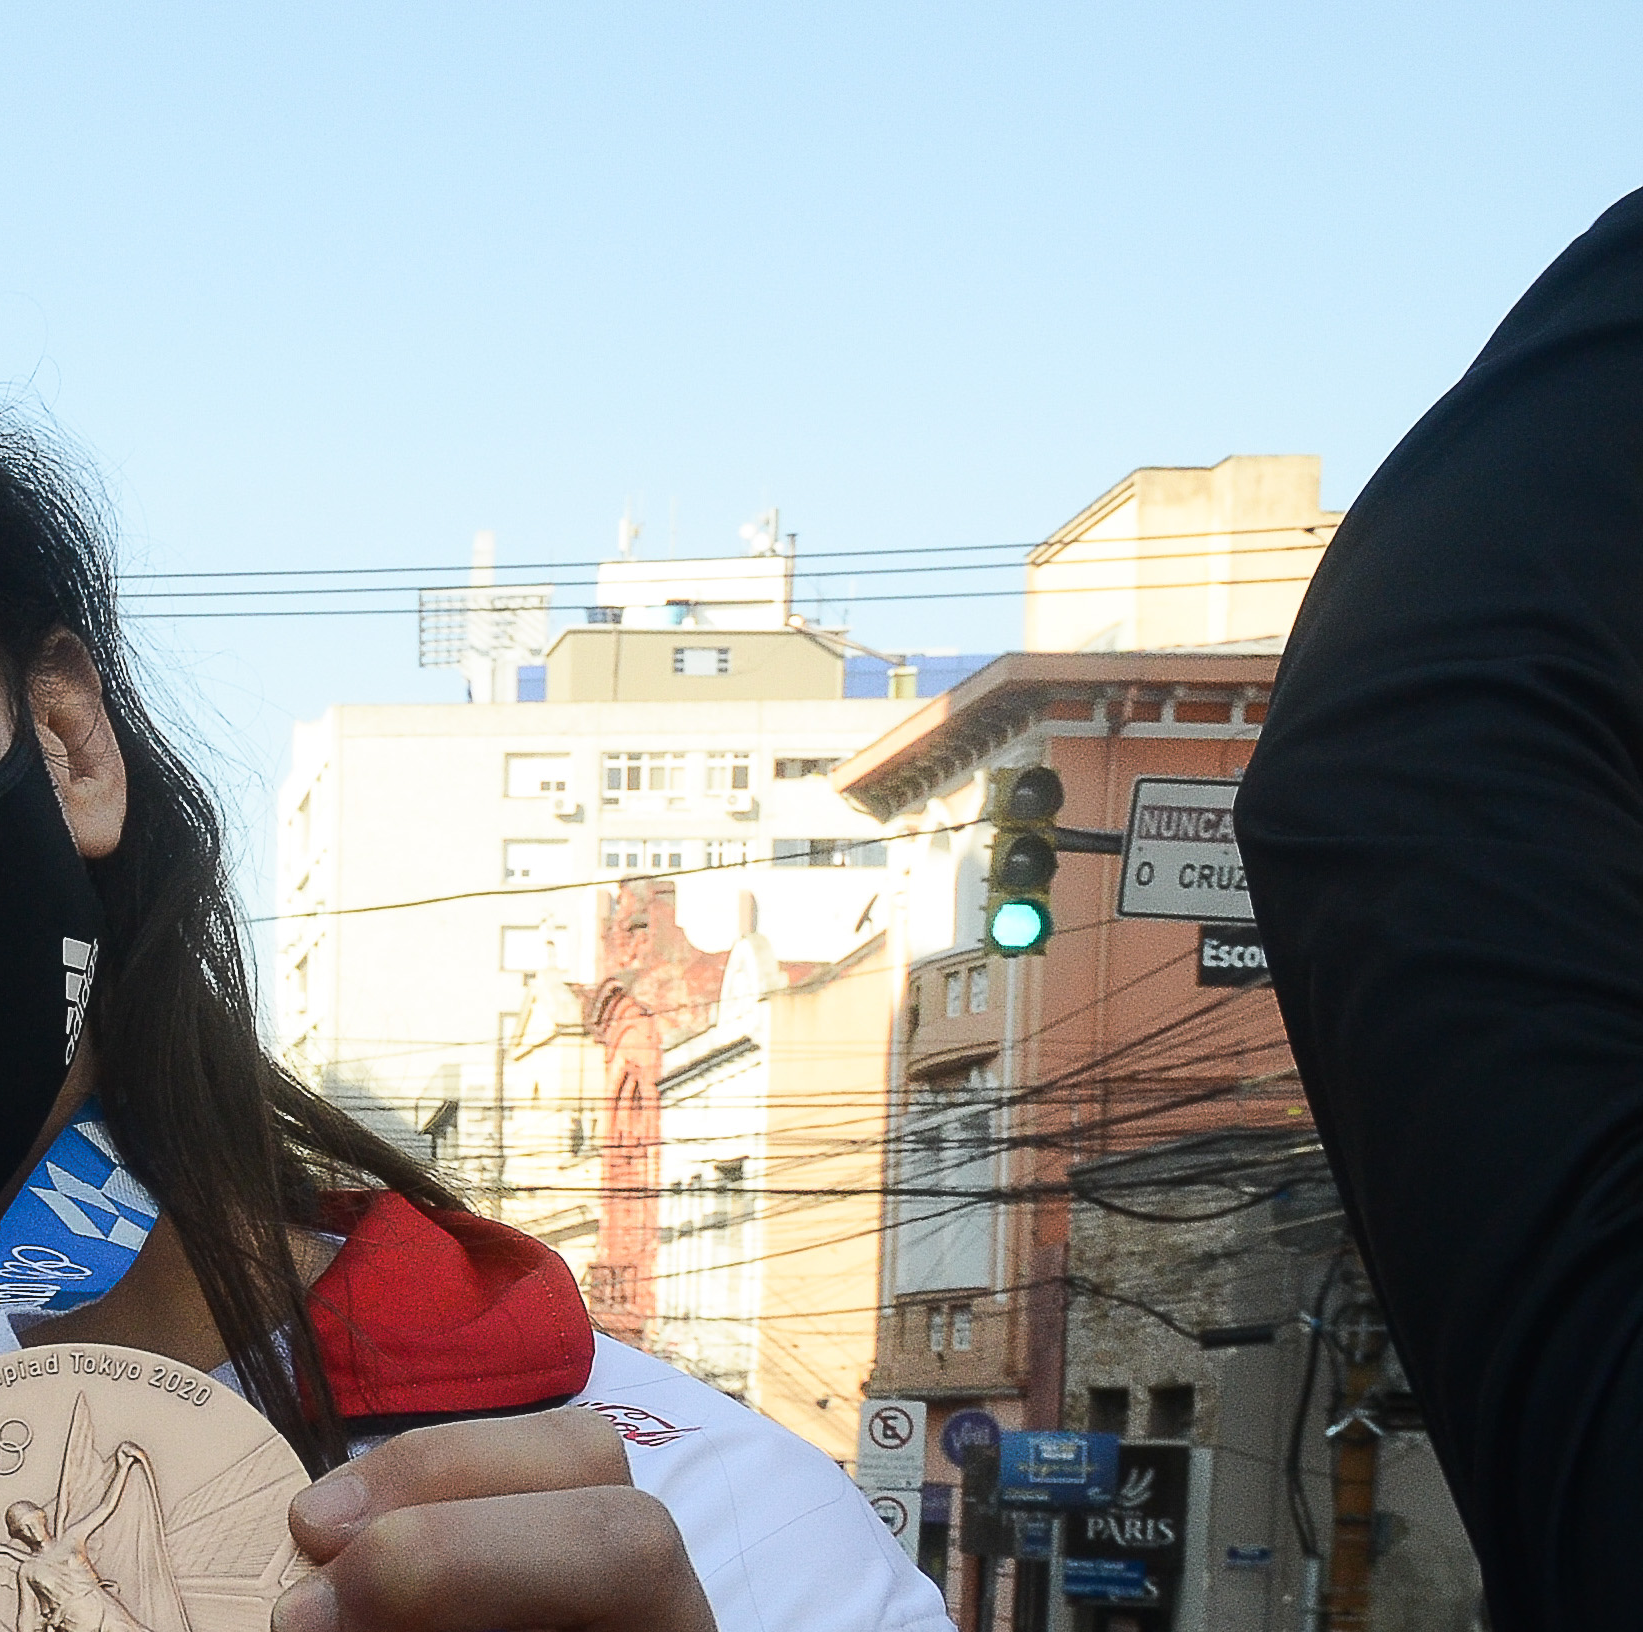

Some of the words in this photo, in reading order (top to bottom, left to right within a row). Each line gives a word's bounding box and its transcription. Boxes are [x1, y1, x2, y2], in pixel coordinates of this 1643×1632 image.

[1139, 808, 1234, 839] NUNCA
[1135, 861, 1155, 886] O
[69, 1351, 143, 1380] Tokyo
[148, 1365, 213, 1407] 2020
[1086, 1517, 1177, 1547] PARIS
